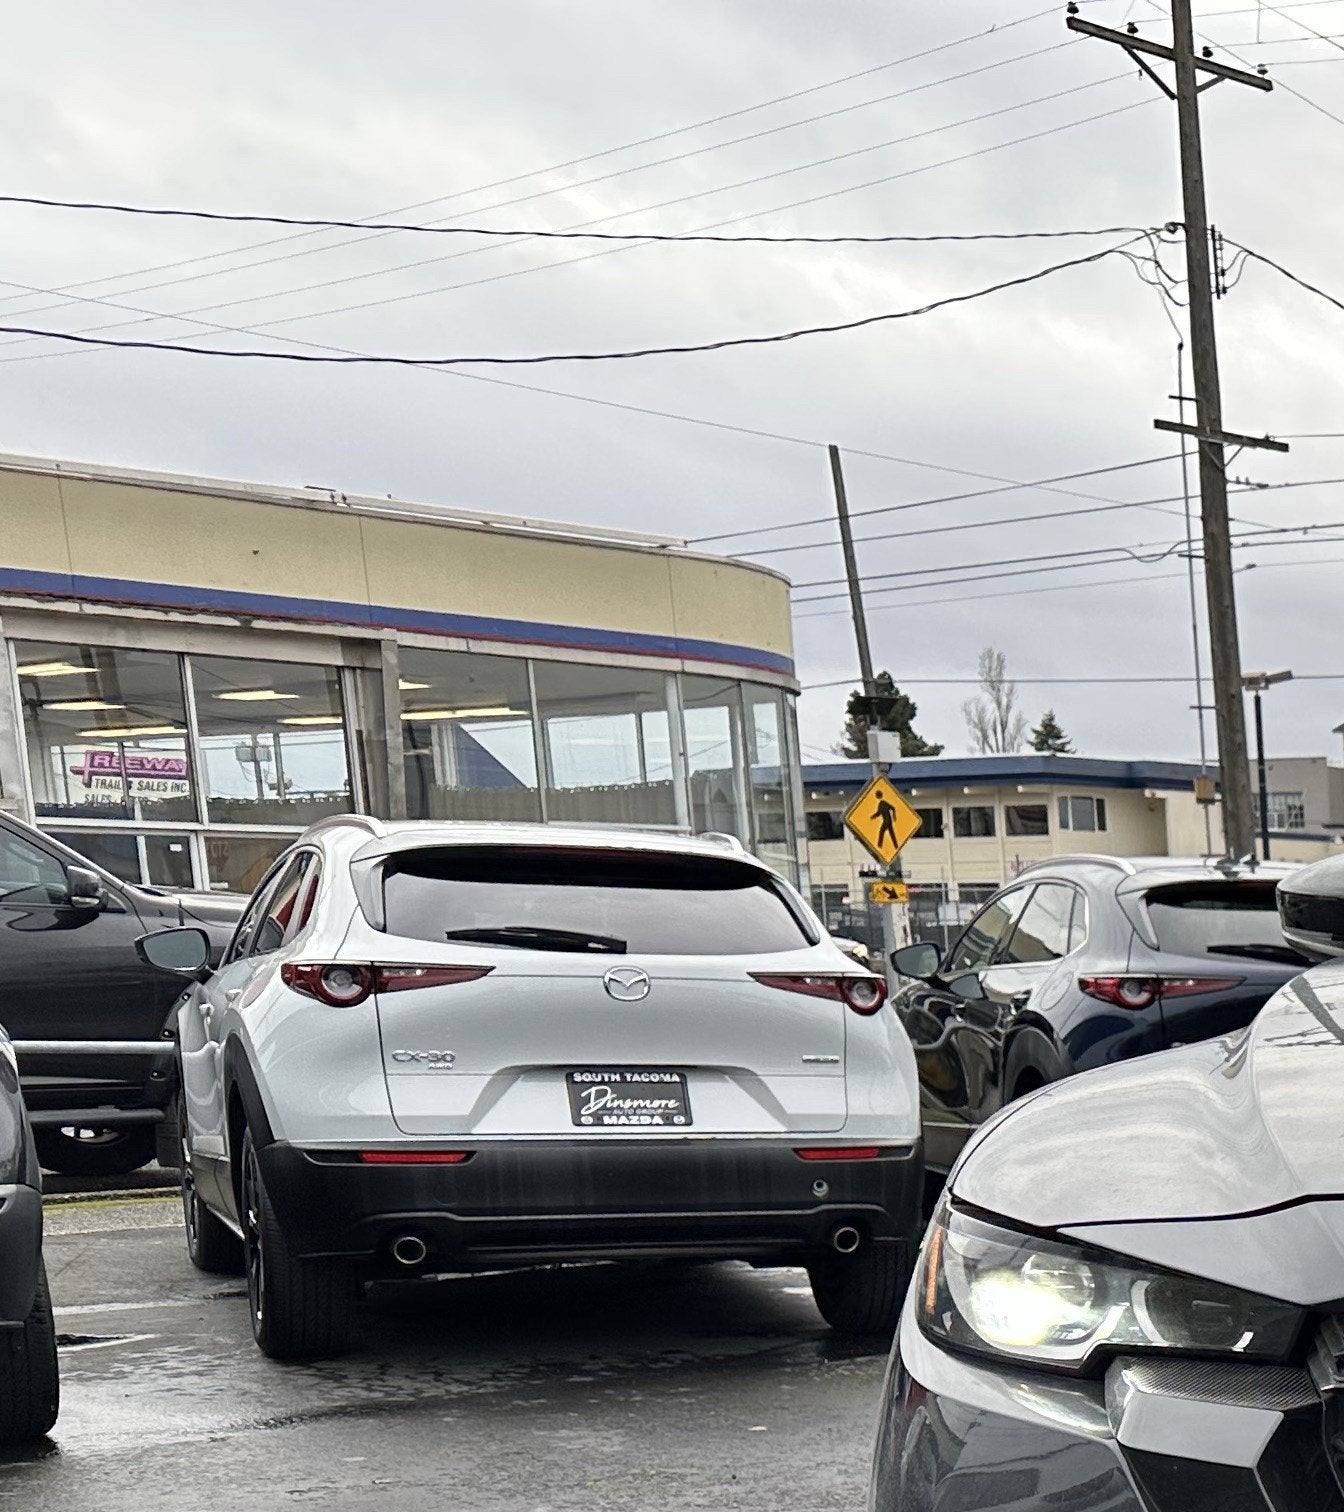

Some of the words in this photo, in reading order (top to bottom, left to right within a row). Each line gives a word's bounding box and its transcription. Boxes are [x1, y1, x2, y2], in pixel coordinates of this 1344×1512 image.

[95, 778, 133, 791] TRAILR
[137, 781, 168, 793] SALES
[573, 1072, 621, 1082] SOUTH
[580, 1085, 680, 1115] Dinsmore
[603, 1115, 664, 1125] MAZDA
